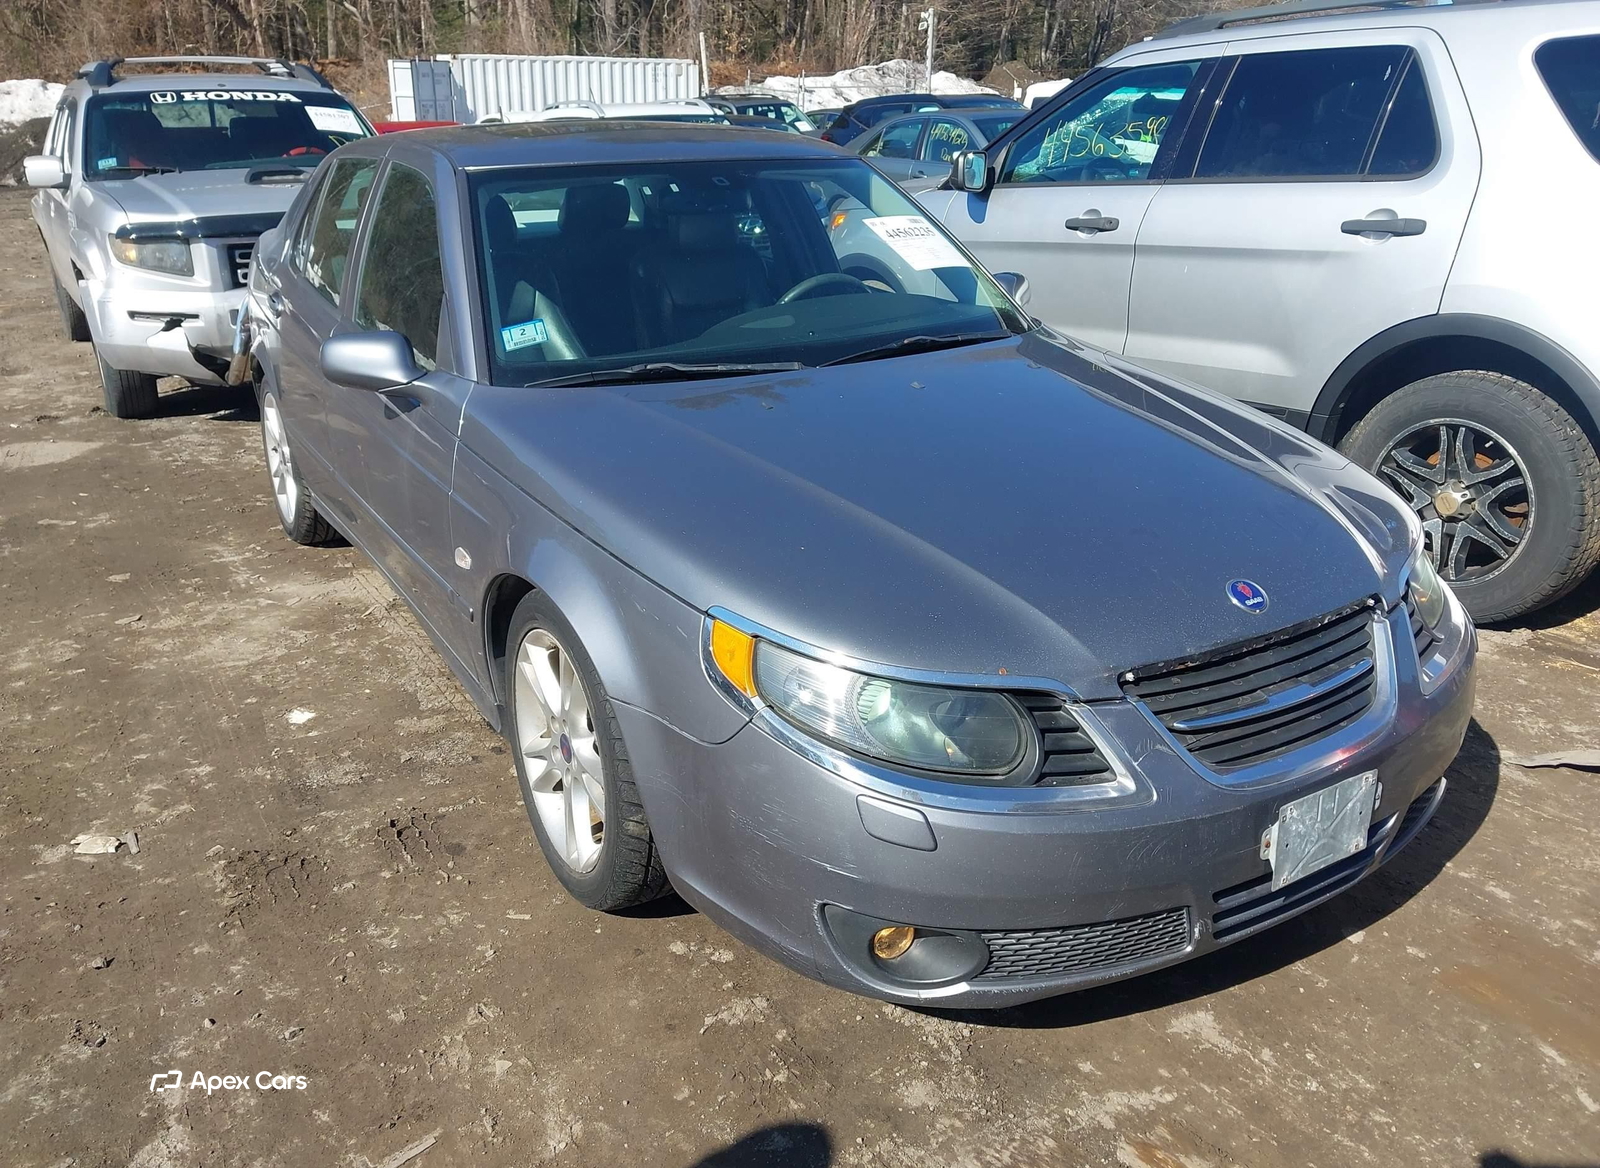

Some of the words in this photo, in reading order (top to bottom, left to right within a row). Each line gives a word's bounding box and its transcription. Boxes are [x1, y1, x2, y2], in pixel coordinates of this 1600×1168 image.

[180, 91, 302, 102] HONDA
[885, 226, 936, 239] 44562235
[519, 328, 527, 336] 2
